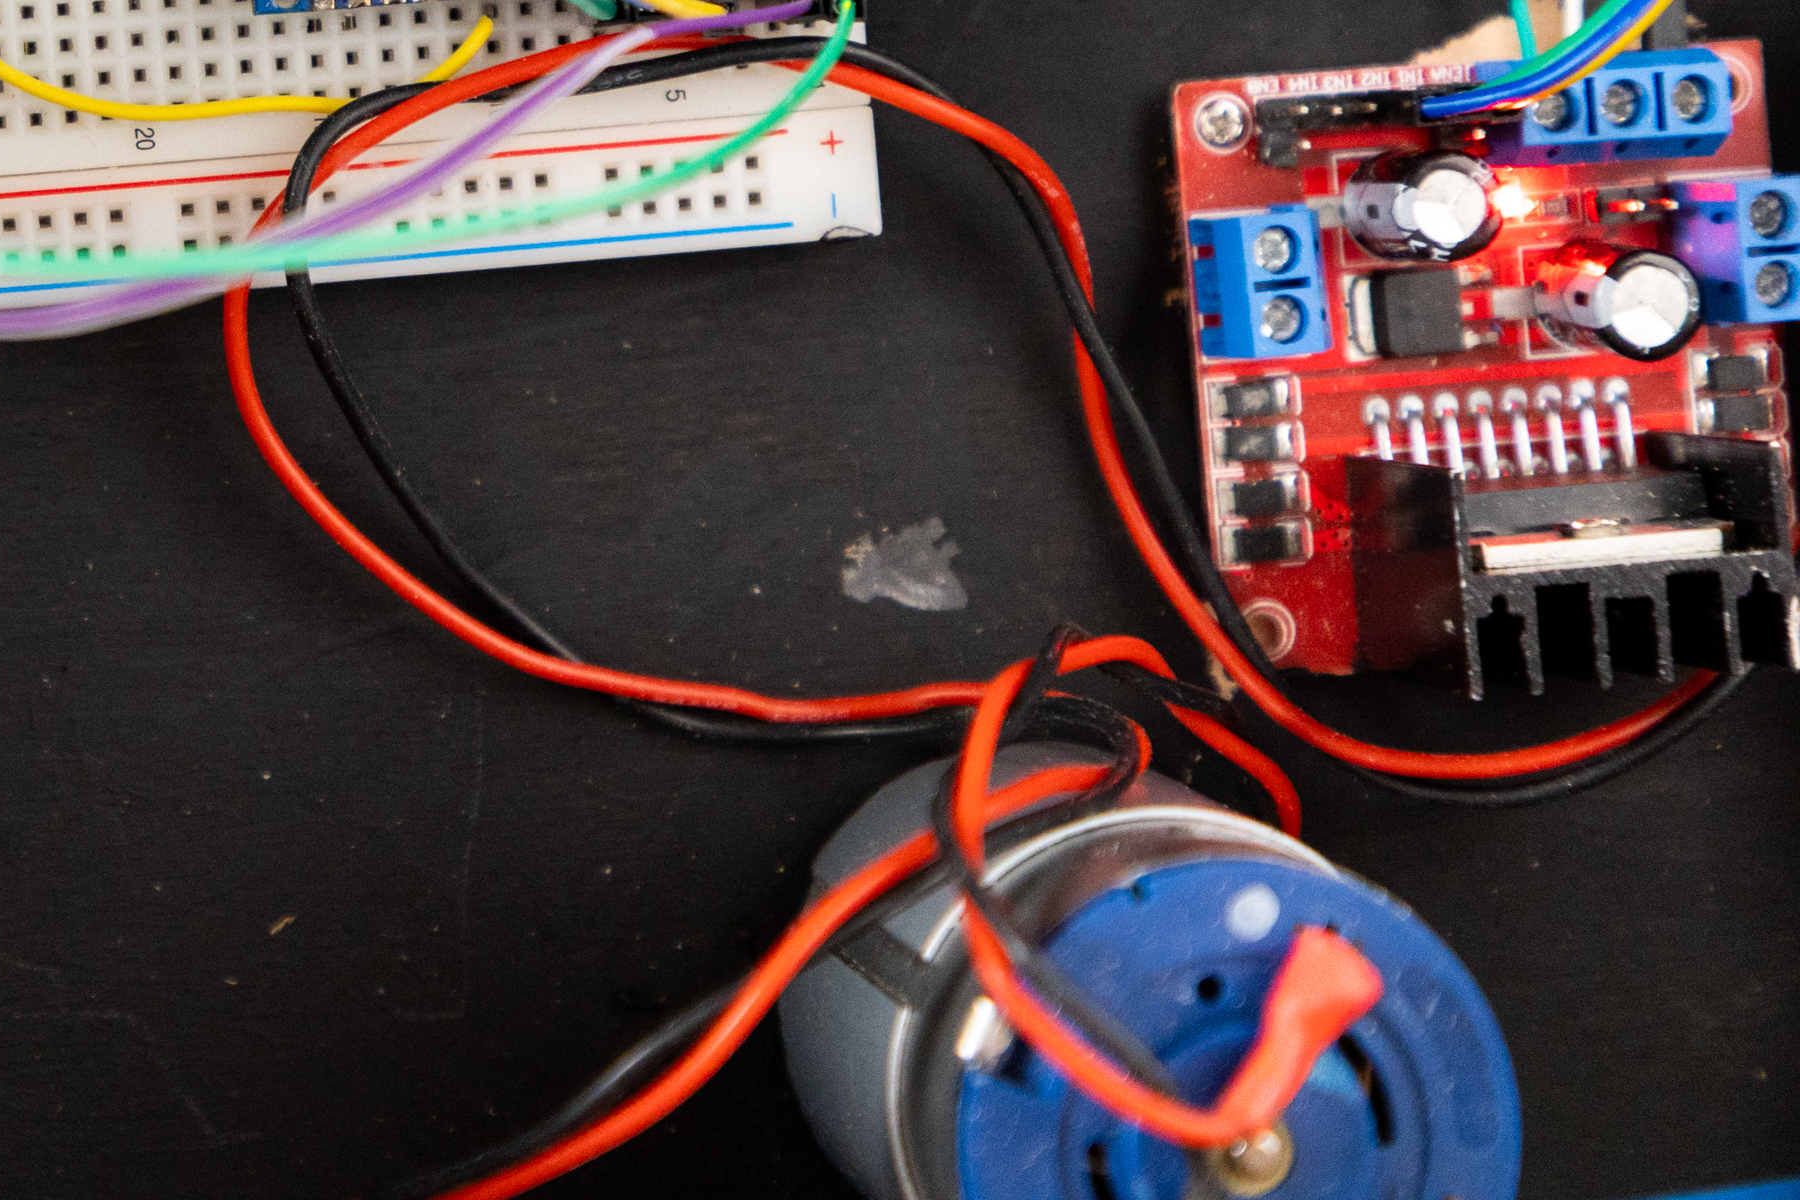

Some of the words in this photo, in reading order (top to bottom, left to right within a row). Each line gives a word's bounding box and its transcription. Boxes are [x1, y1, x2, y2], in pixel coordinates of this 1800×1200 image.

[1247, 78, 1280, 95] ENB
[1290, 75, 1318, 93] IN4
[1324, 73, 1354, 90] IN3
[1361, 70, 1392, 88] IN2
[665, 89, 687, 102] 5
[135, 128, 155, 150] 20
